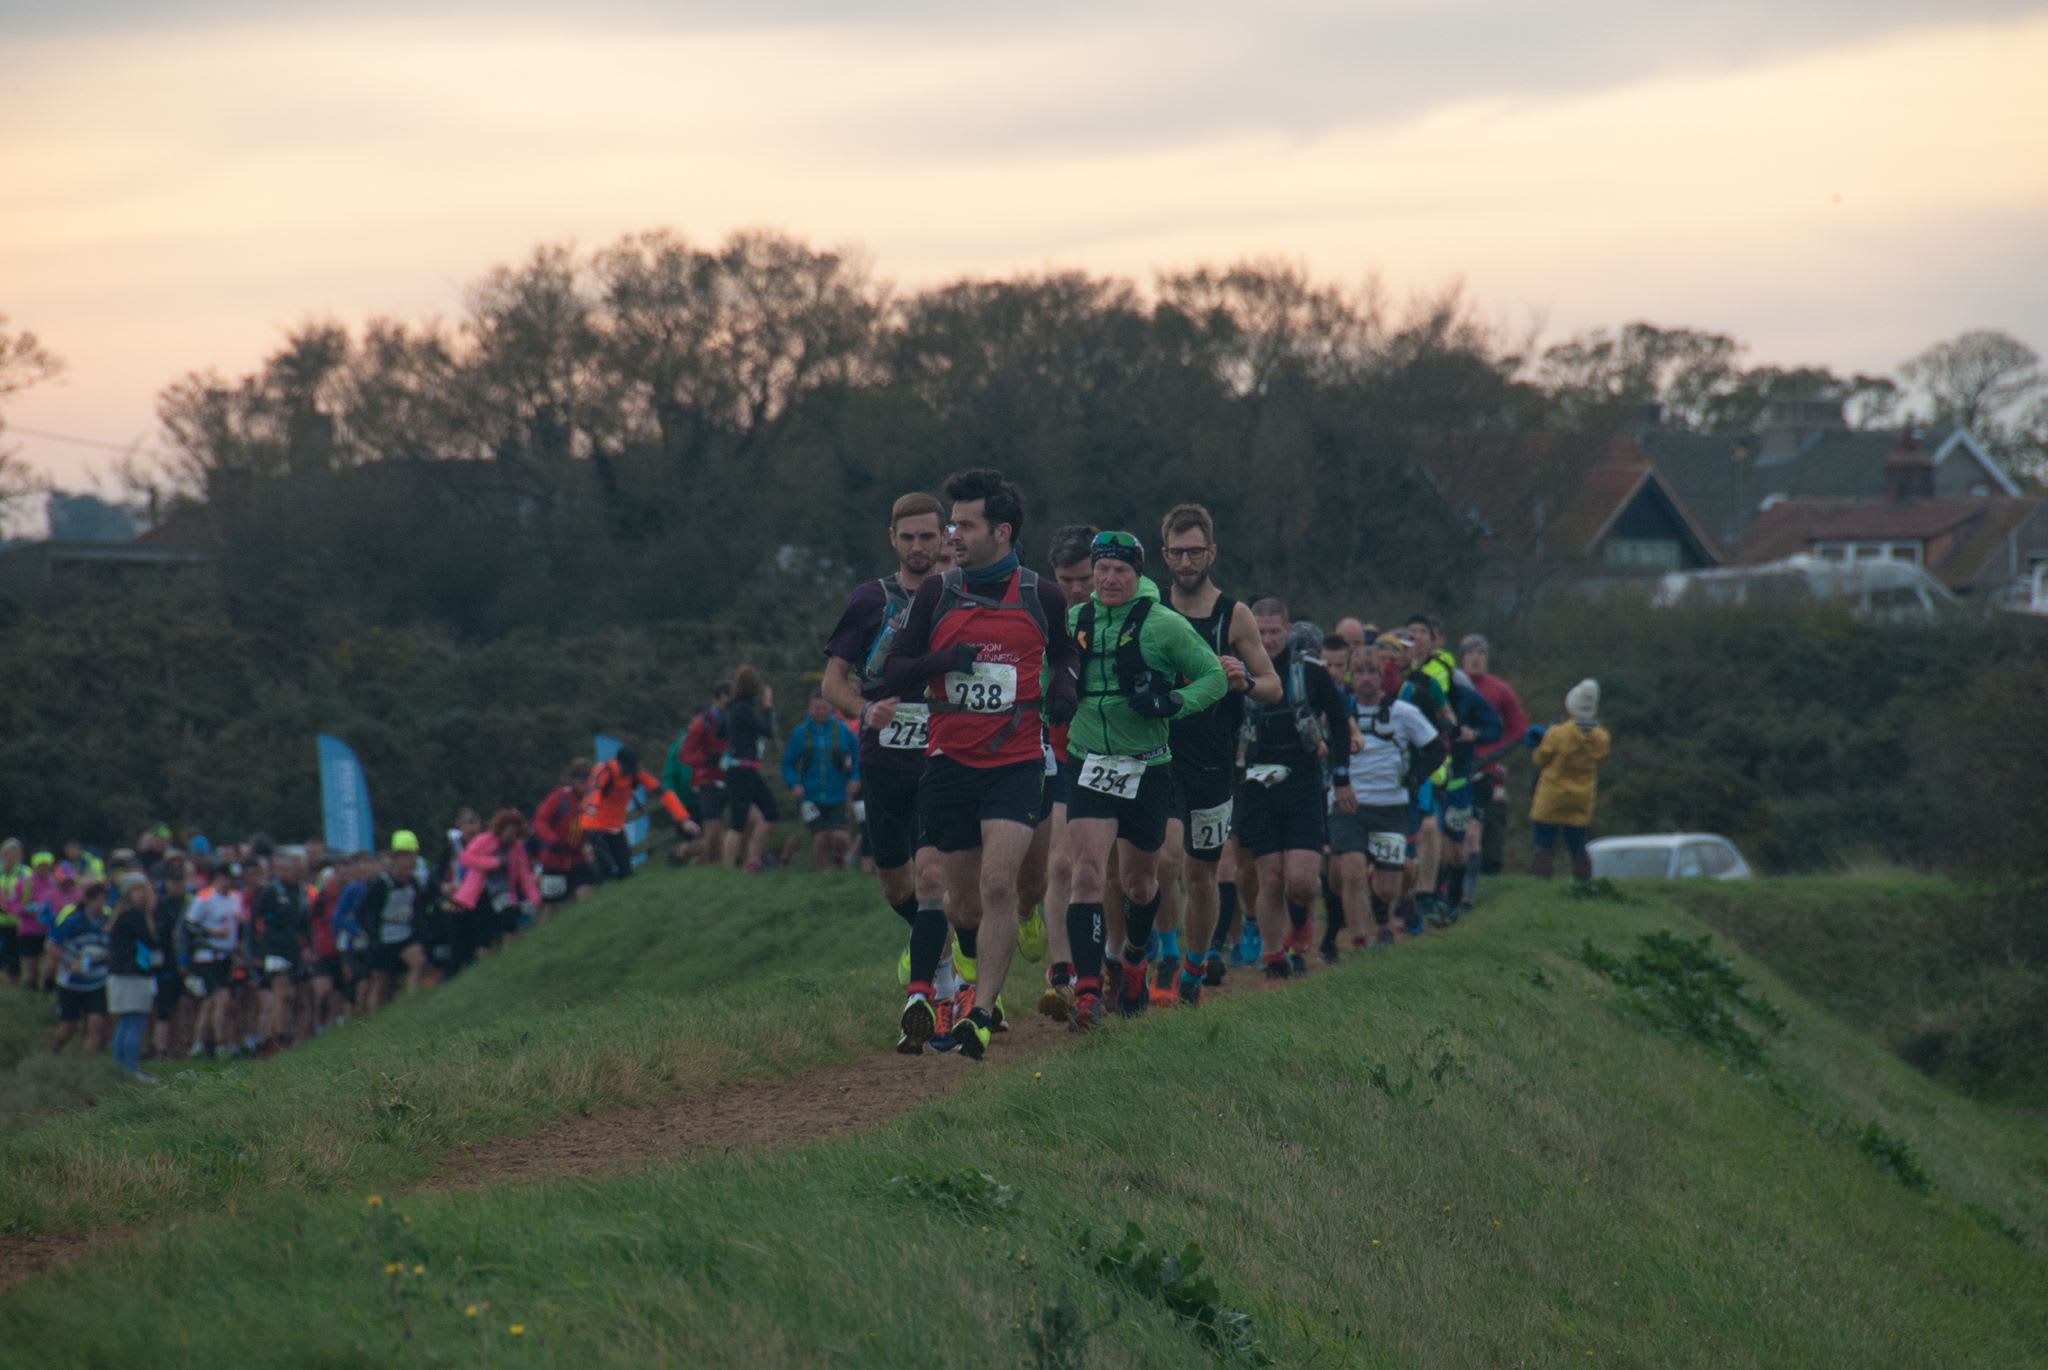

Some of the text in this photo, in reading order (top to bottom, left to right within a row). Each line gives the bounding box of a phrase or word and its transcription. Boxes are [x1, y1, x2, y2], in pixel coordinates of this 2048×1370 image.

[966, 643, 1002, 652] DON
[955, 683, 1002, 711] 238
[889, 721, 929, 746] 275
[1088, 766, 1131, 794] 254
[1092, 912, 1102, 943] 2XU
